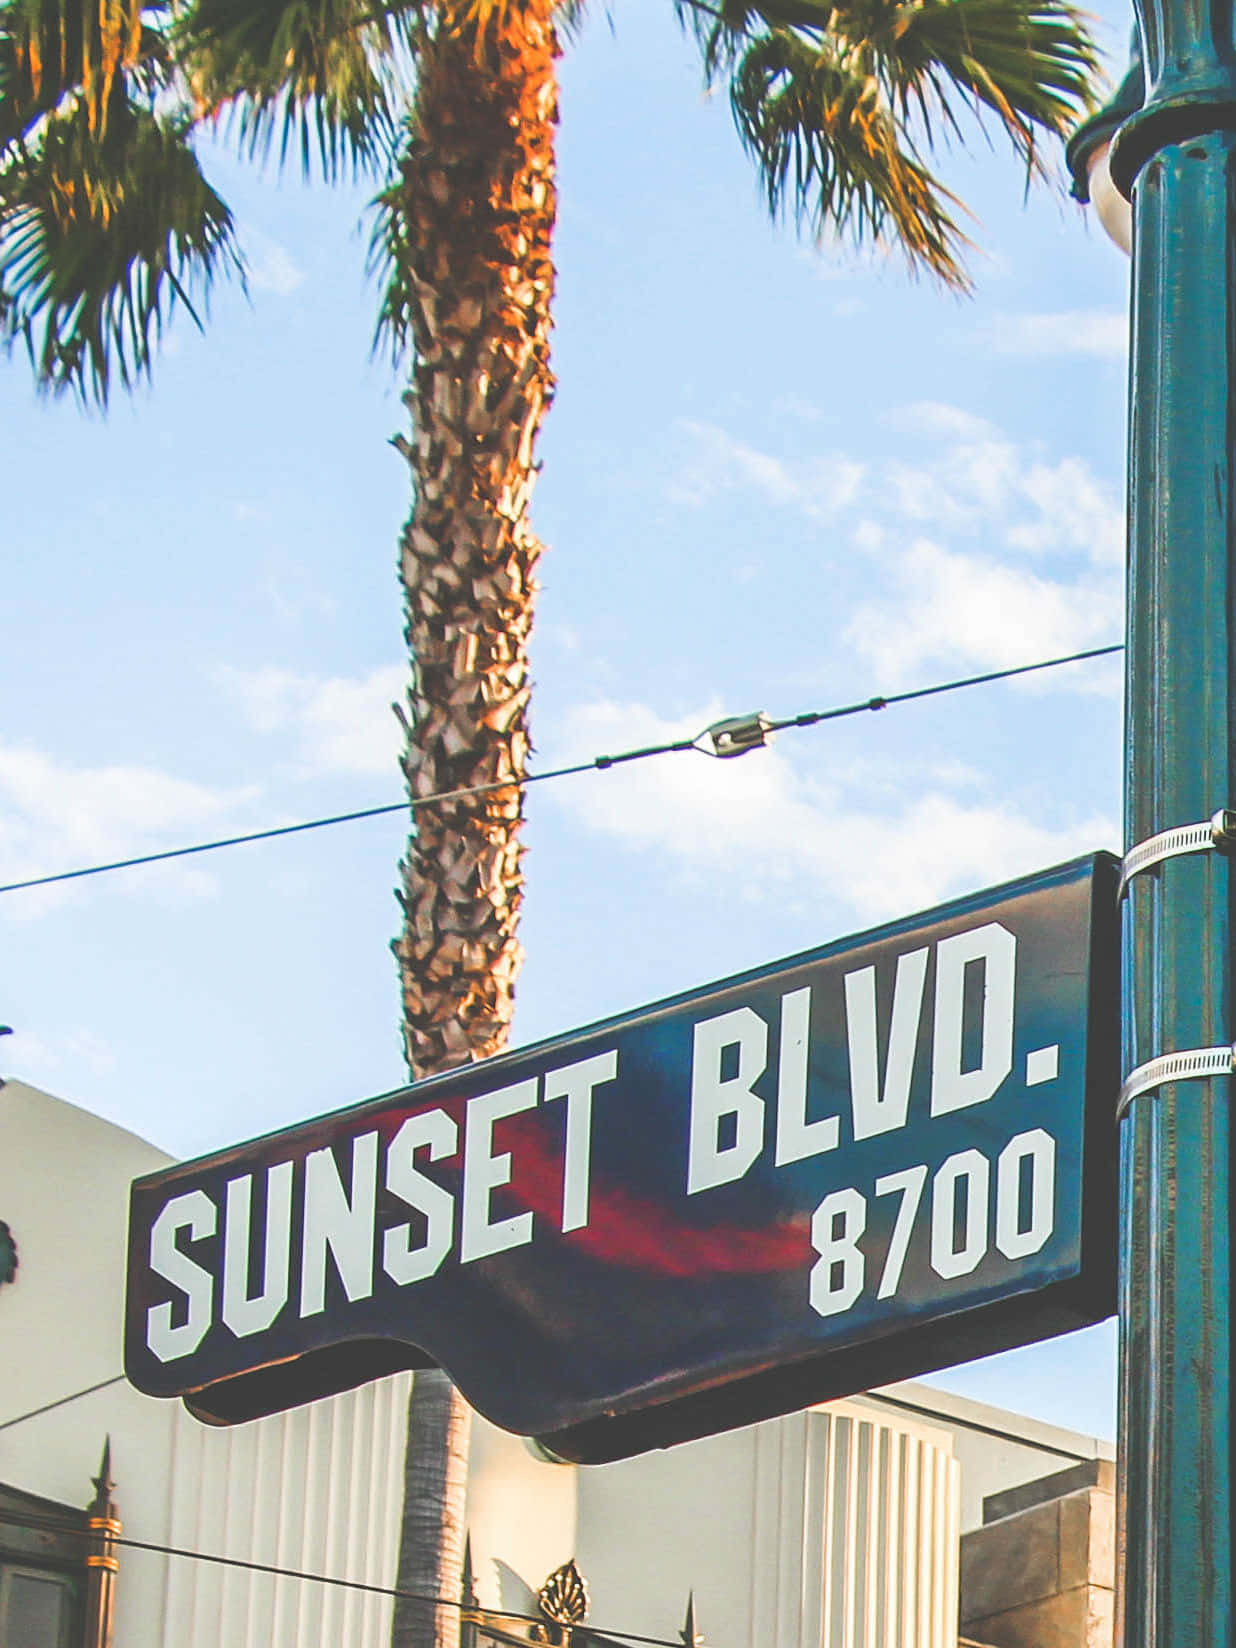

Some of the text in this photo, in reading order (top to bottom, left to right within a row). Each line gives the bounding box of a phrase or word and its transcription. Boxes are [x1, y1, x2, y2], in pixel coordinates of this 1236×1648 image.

[146, 922, 1059, 1363] SUNSET BLVD.
[808, 1127, 1056, 1319] 8700
